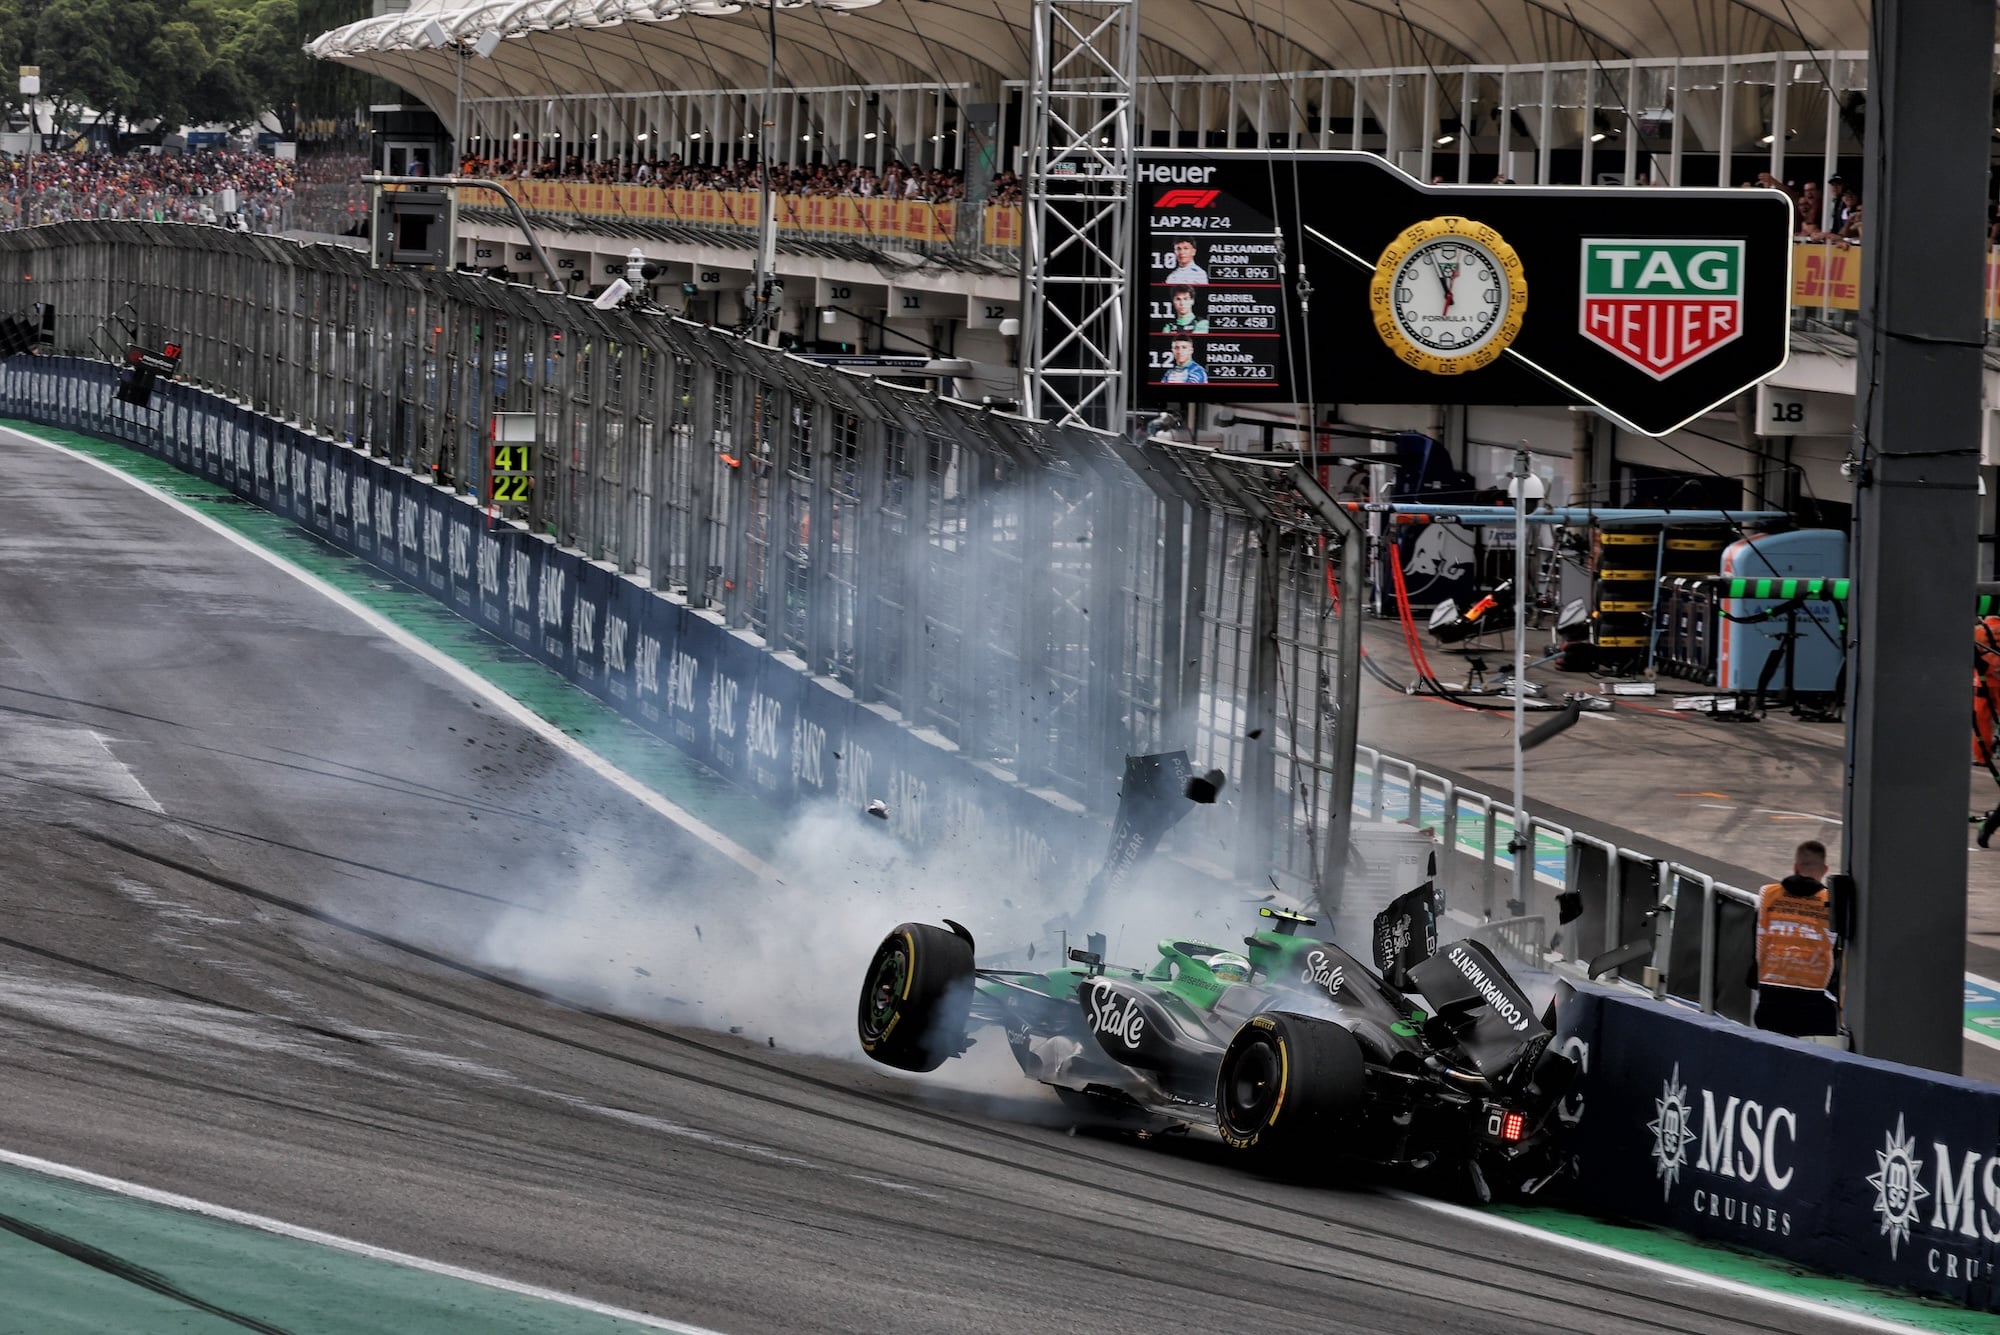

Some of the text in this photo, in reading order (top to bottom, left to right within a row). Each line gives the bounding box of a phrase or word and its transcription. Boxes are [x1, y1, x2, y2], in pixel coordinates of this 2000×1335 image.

[1137, 163, 1217, 183] Heuer
[387, 232, 394, 241] 2
[515, 251, 531, 261] 04
[1209, 244, 1278, 254] ALEXANDER
[558, 259, 575, 269] 05
[1151, 252, 1177, 269] 10
[1209, 255, 1249, 264] ALBON
[606, 264, 623, 275] 06
[701, 271, 720, 283] 08
[1595, 250, 1728, 290] TAG
[831, 287, 850, 299] 10
[1208, 294, 1256, 303] GABRIEL
[903, 297, 920, 309] 11
[1150, 301, 1175, 318] 11
[1207, 305, 1276, 314] BORTOLETO
[985, 306, 1004, 319] 12
[1591, 304, 1732, 368] HEUER
[1206, 343, 1240, 352] ISACK
[1149, 351, 1174, 368] 12
[1206, 354, 1253, 363] HADJAR
[1213, 367, 1267, 377] +26.716
[1772, 403, 1804, 422] 18
[495, 446, 528, 471] 41
[494, 476, 528, 501] 22
[1379, 914, 1395, 969] SINGHA
[1301, 951, 1345, 995] Stake
[1449, 947, 1521, 1025] COINPAYMENTS
[1087, 981, 1145, 1049] Stake
[1696, 1089, 1796, 1191] MSC
[1693, 1189, 1792, 1237] CRUISES
